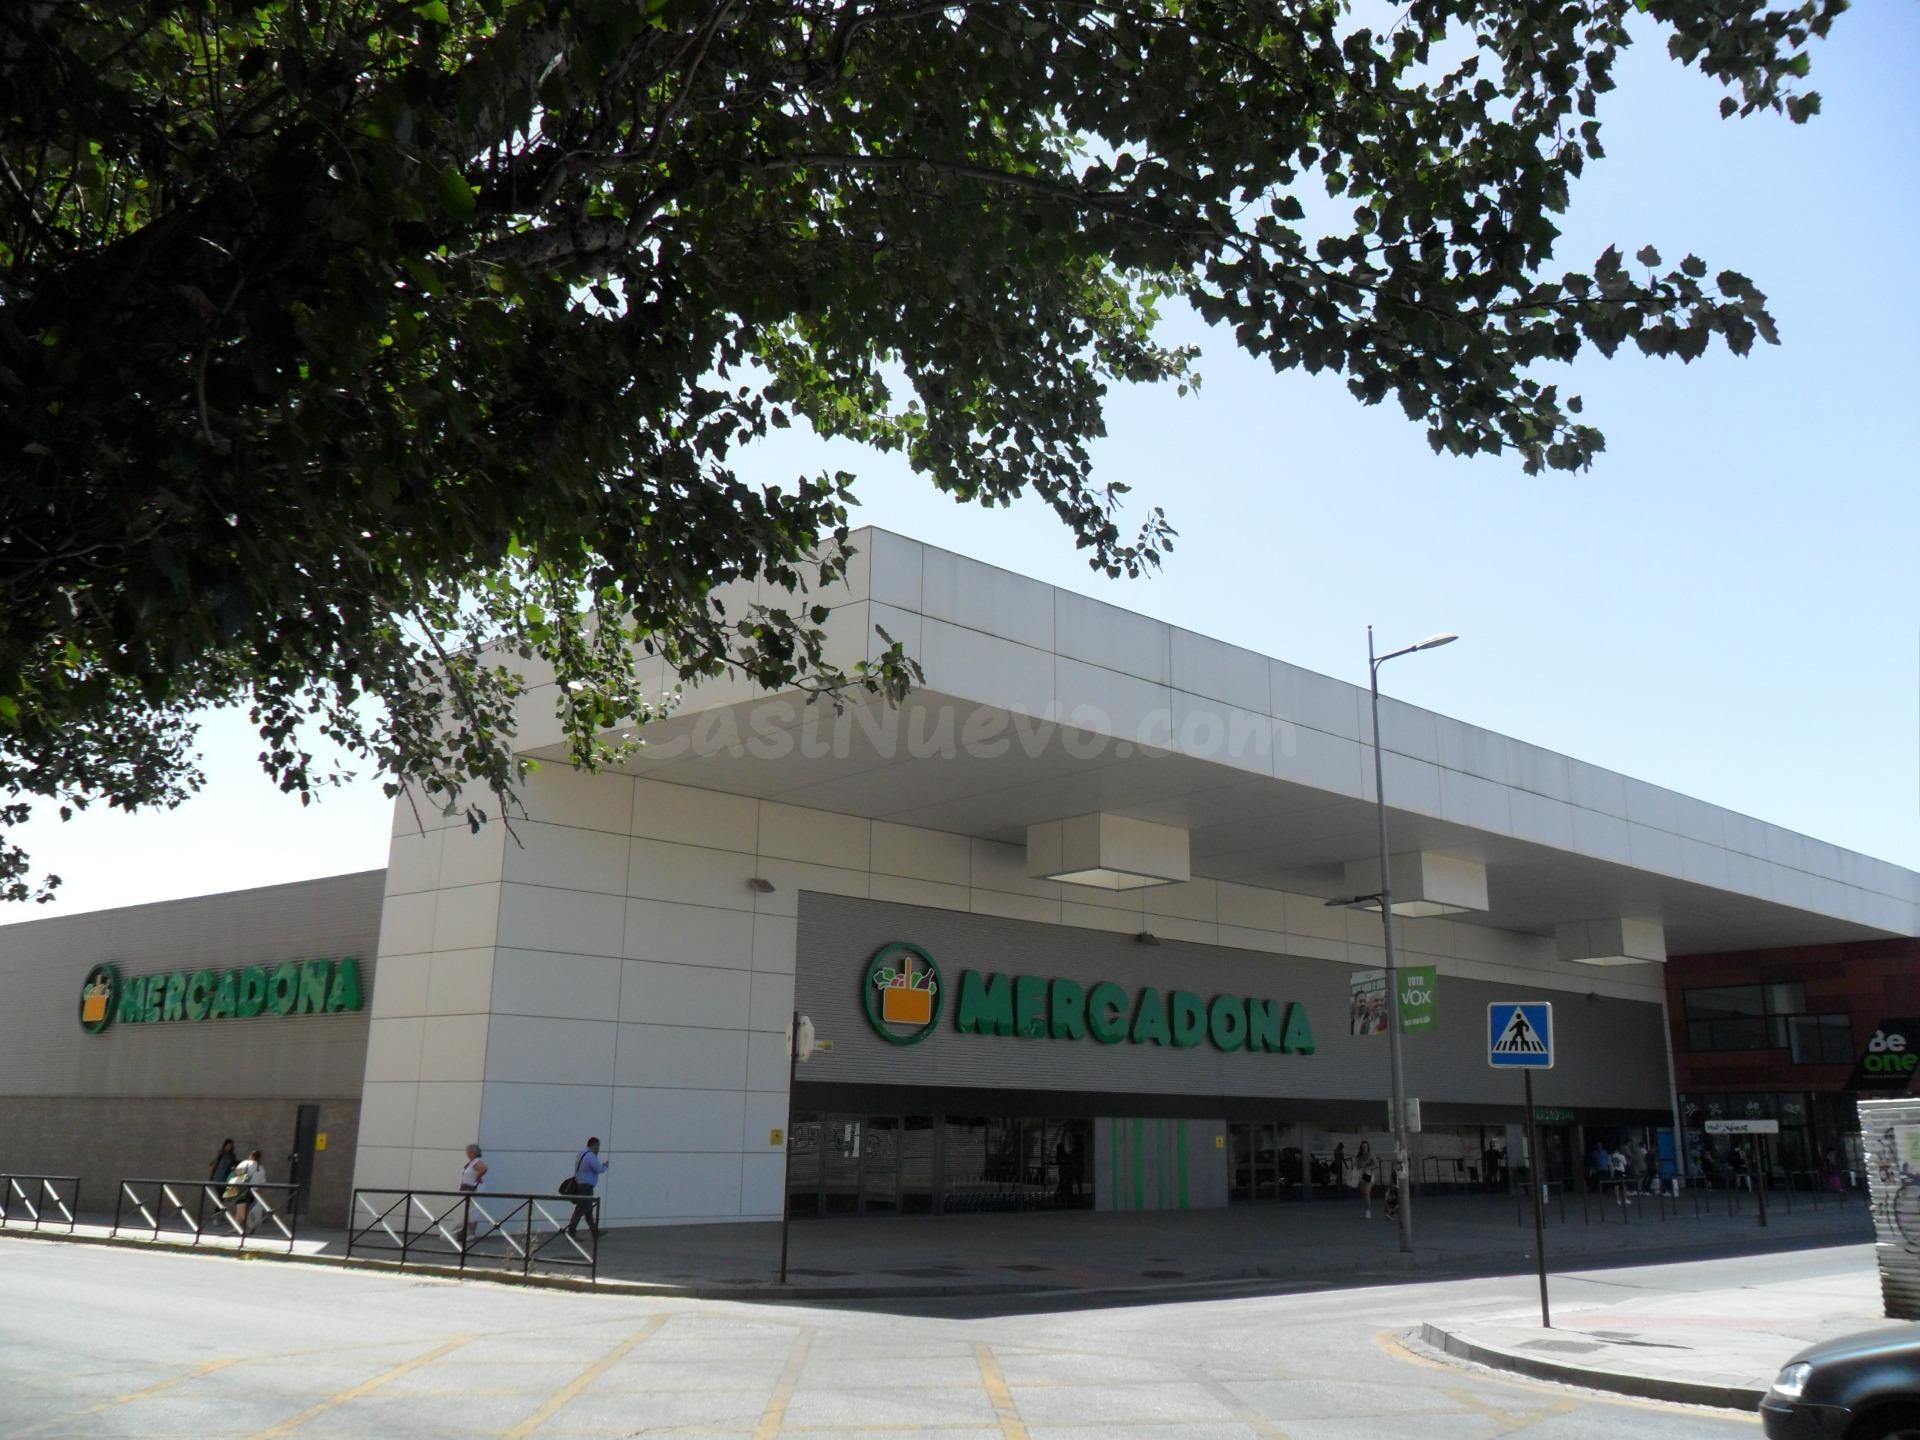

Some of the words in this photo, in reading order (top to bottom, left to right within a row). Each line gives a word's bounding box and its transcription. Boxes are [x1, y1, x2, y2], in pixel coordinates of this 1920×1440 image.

[116, 955, 361, 1023] MERCADONA
[1407, 976, 1424, 986] VOTA
[1402, 988, 1432, 1006] VOX
[956, 969, 1316, 1055] MERCADONA
[1863, 1053, 1918, 1073] one
